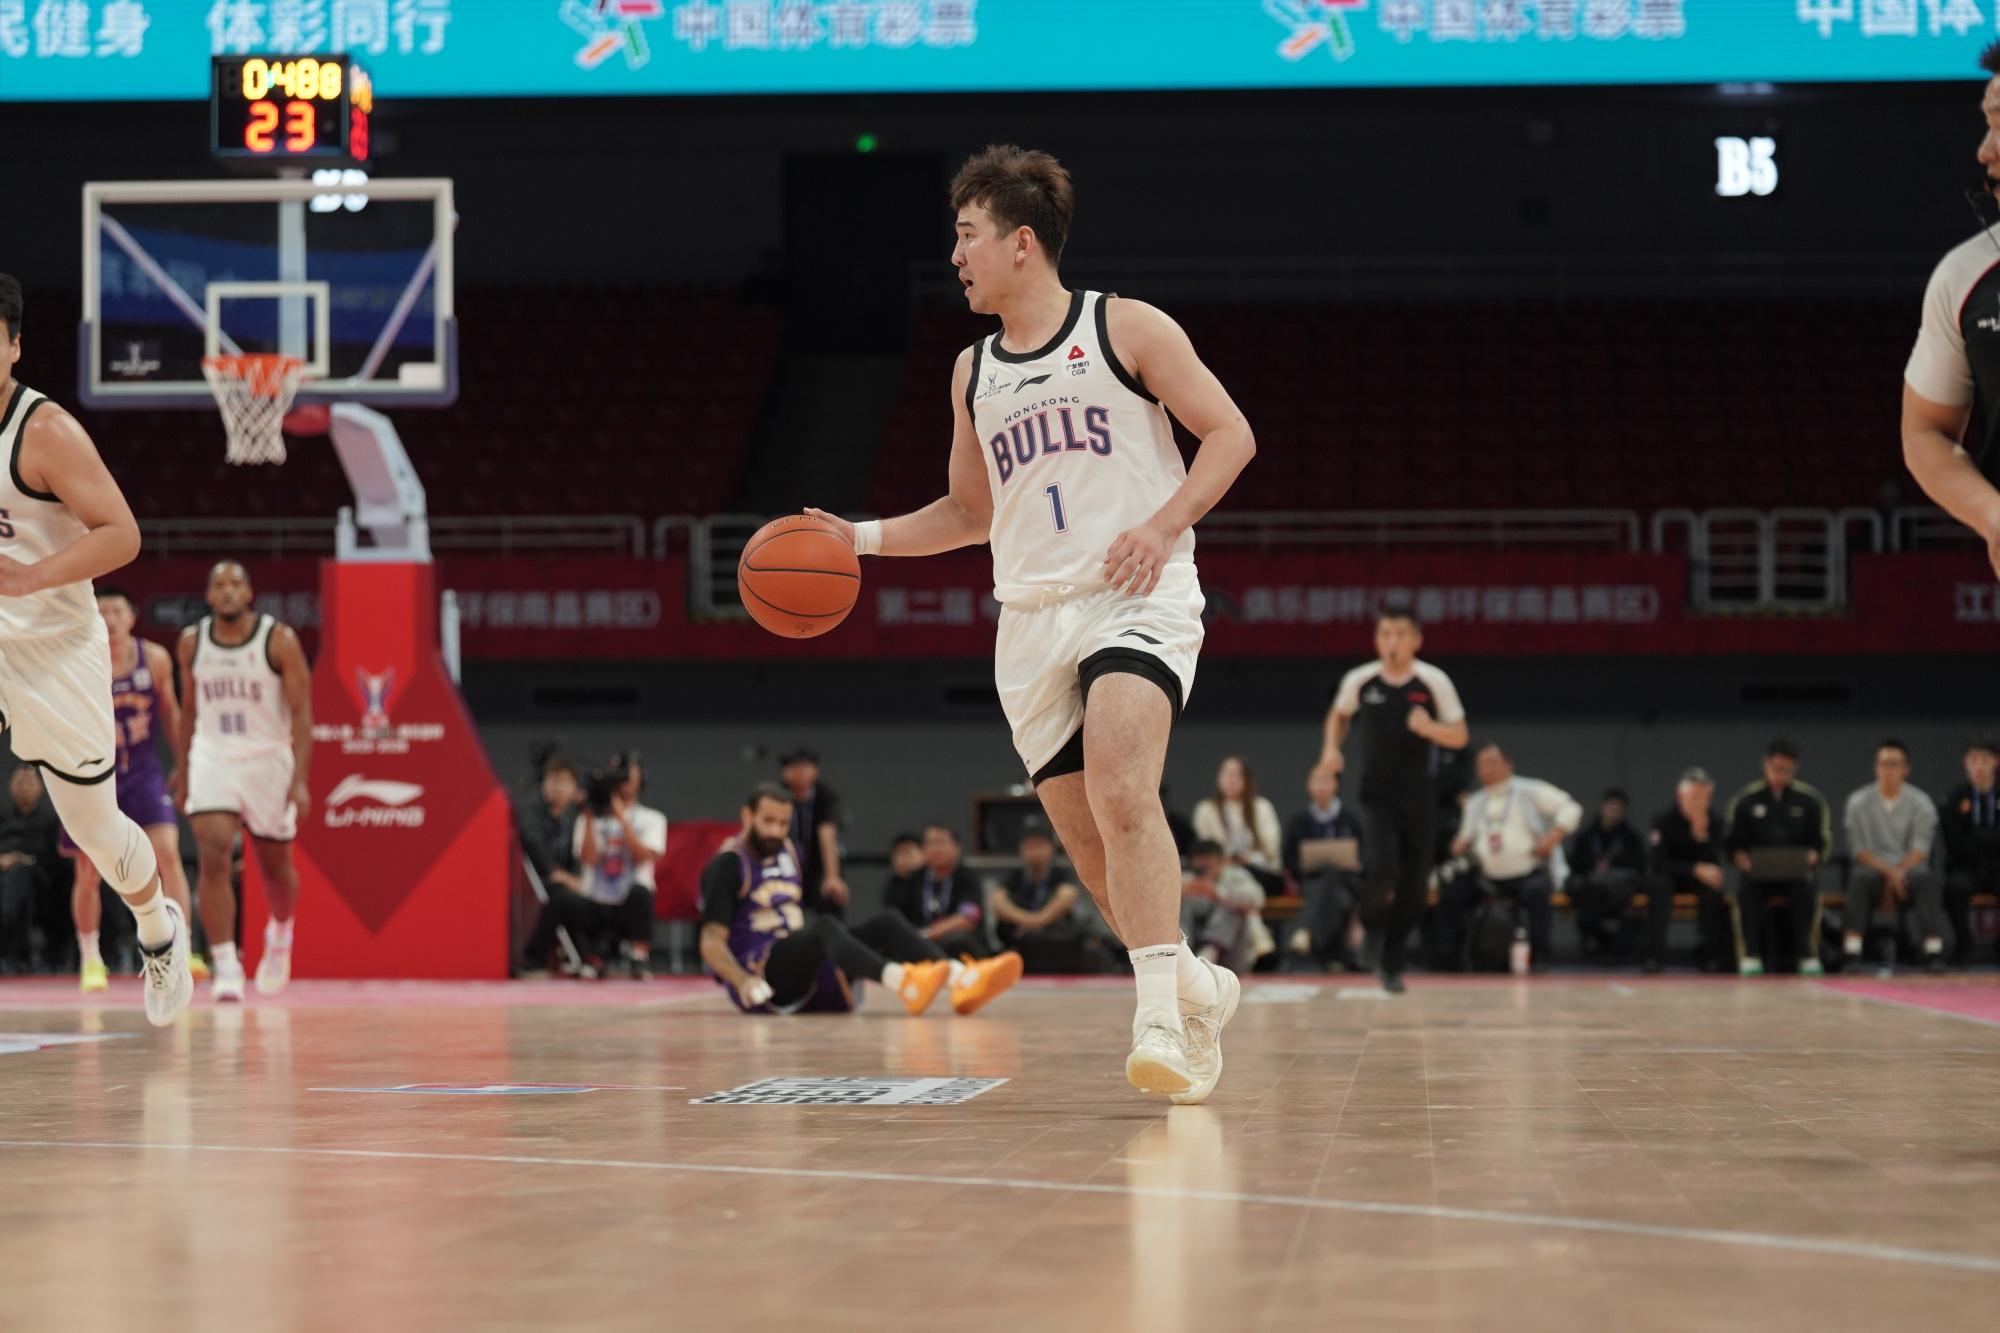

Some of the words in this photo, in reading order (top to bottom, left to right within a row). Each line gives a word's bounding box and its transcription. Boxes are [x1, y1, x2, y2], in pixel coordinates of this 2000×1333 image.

[674, 0, 977, 51] 中国体育彩票
[1796, 0, 2000, 39] 中国体
[245, 100, 315, 153] 23
[1714, 136, 1778, 196] B5
[1071, 368, 1087, 376] CGB
[989, 405, 1113, 486] BULLS
[1043, 481, 1069, 534] 1
[1954, 583, 2000, 623] 江
